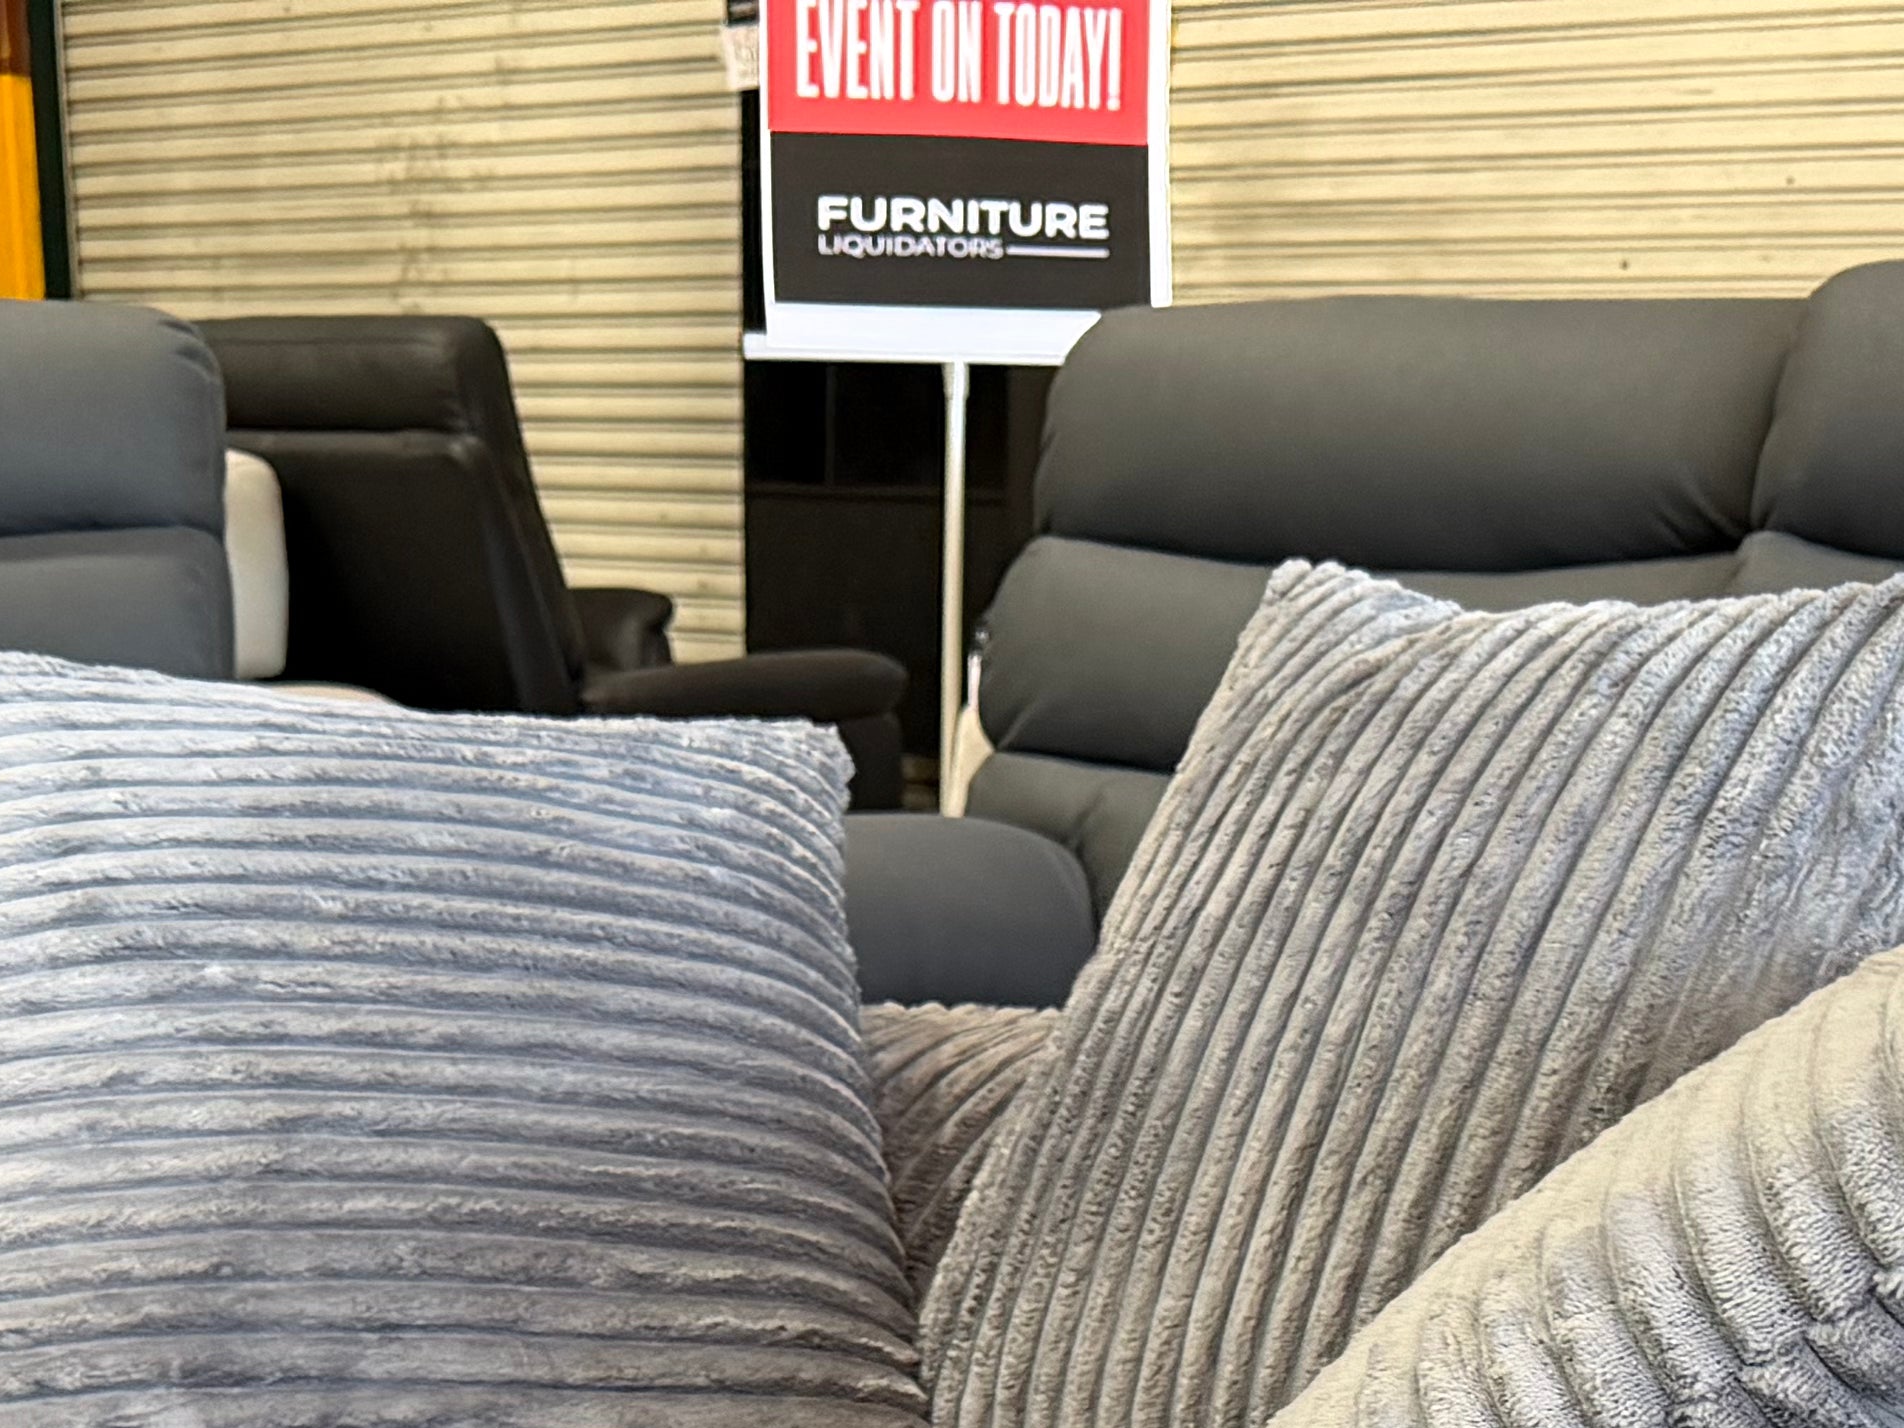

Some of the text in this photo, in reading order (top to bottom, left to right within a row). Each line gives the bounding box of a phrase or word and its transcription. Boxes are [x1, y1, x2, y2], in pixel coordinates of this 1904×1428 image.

[796, 0, 1123, 111] EVENT ON TODAY!
[817, 195, 1110, 240] FURNITURE
[818, 233, 1004, 259] LIQUIDATORS
